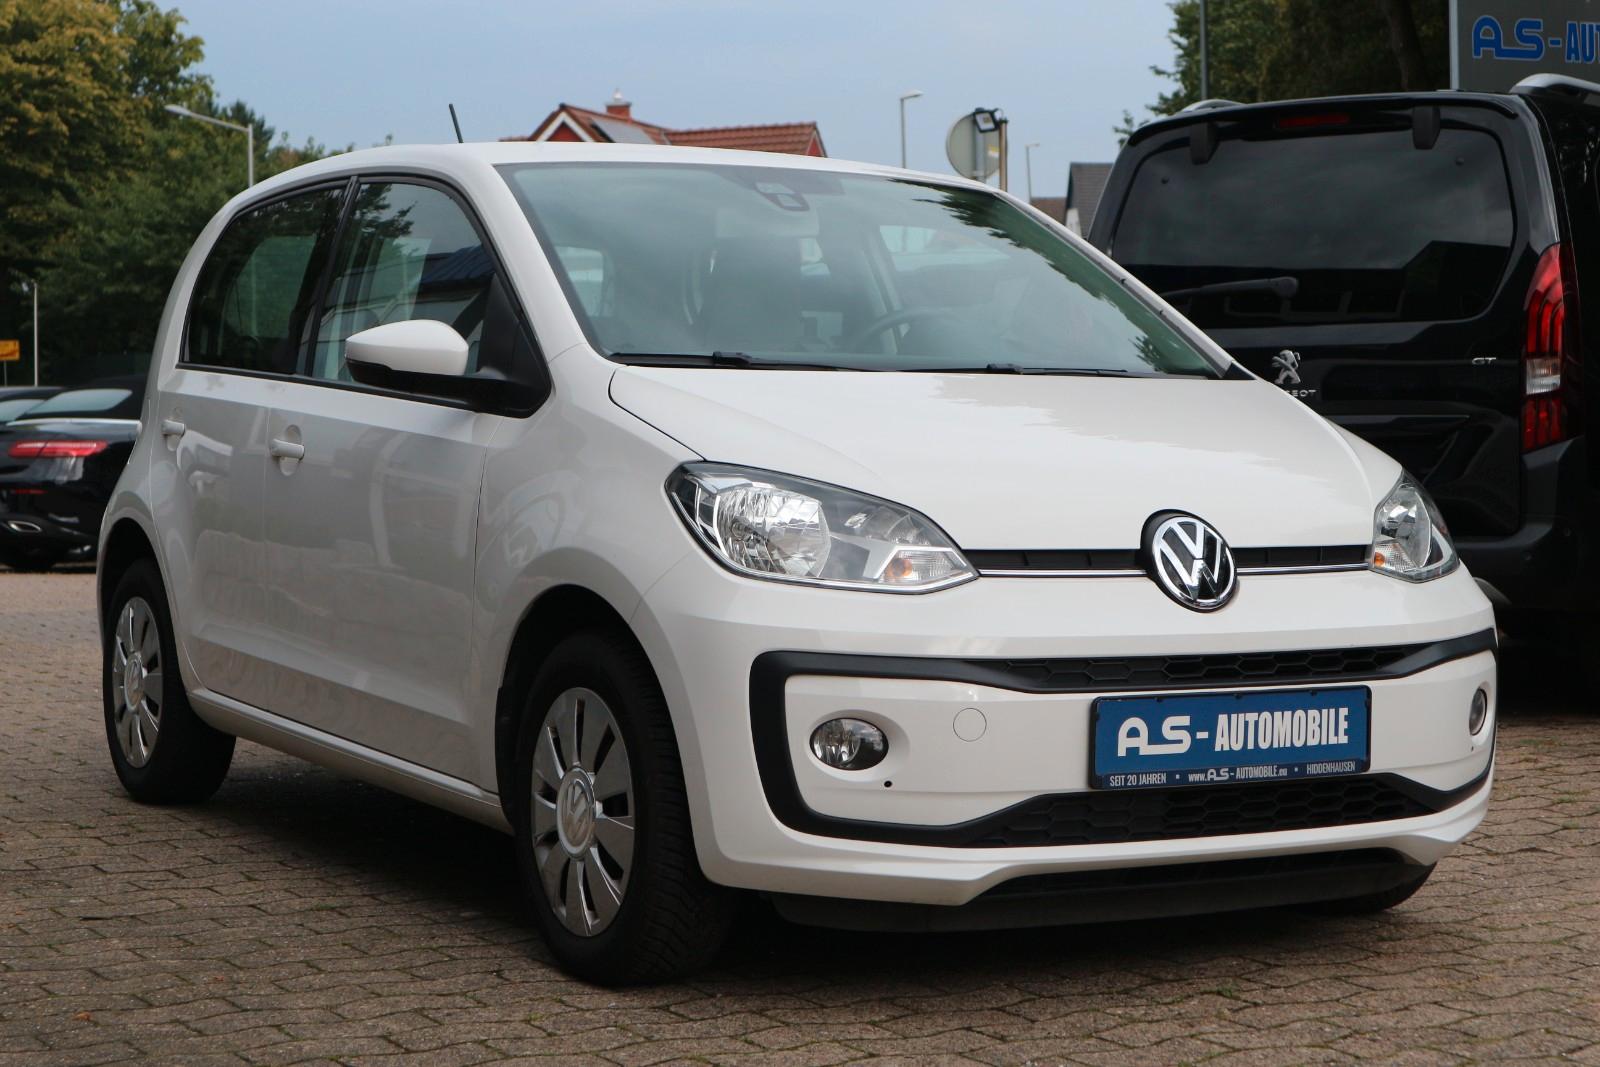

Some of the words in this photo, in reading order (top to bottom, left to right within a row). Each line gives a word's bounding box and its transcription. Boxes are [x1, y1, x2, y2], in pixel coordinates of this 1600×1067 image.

[1471, 357, 1497, 365] GT
[1155, 517, 1229, 605] VW
[1109, 775, 1125, 787] SEIT
[1126, 774, 1137, 786] 20
[1138, 773, 1167, 785] JAHREN
[1306, 761, 1356, 775] HIDDENHAUSEN
